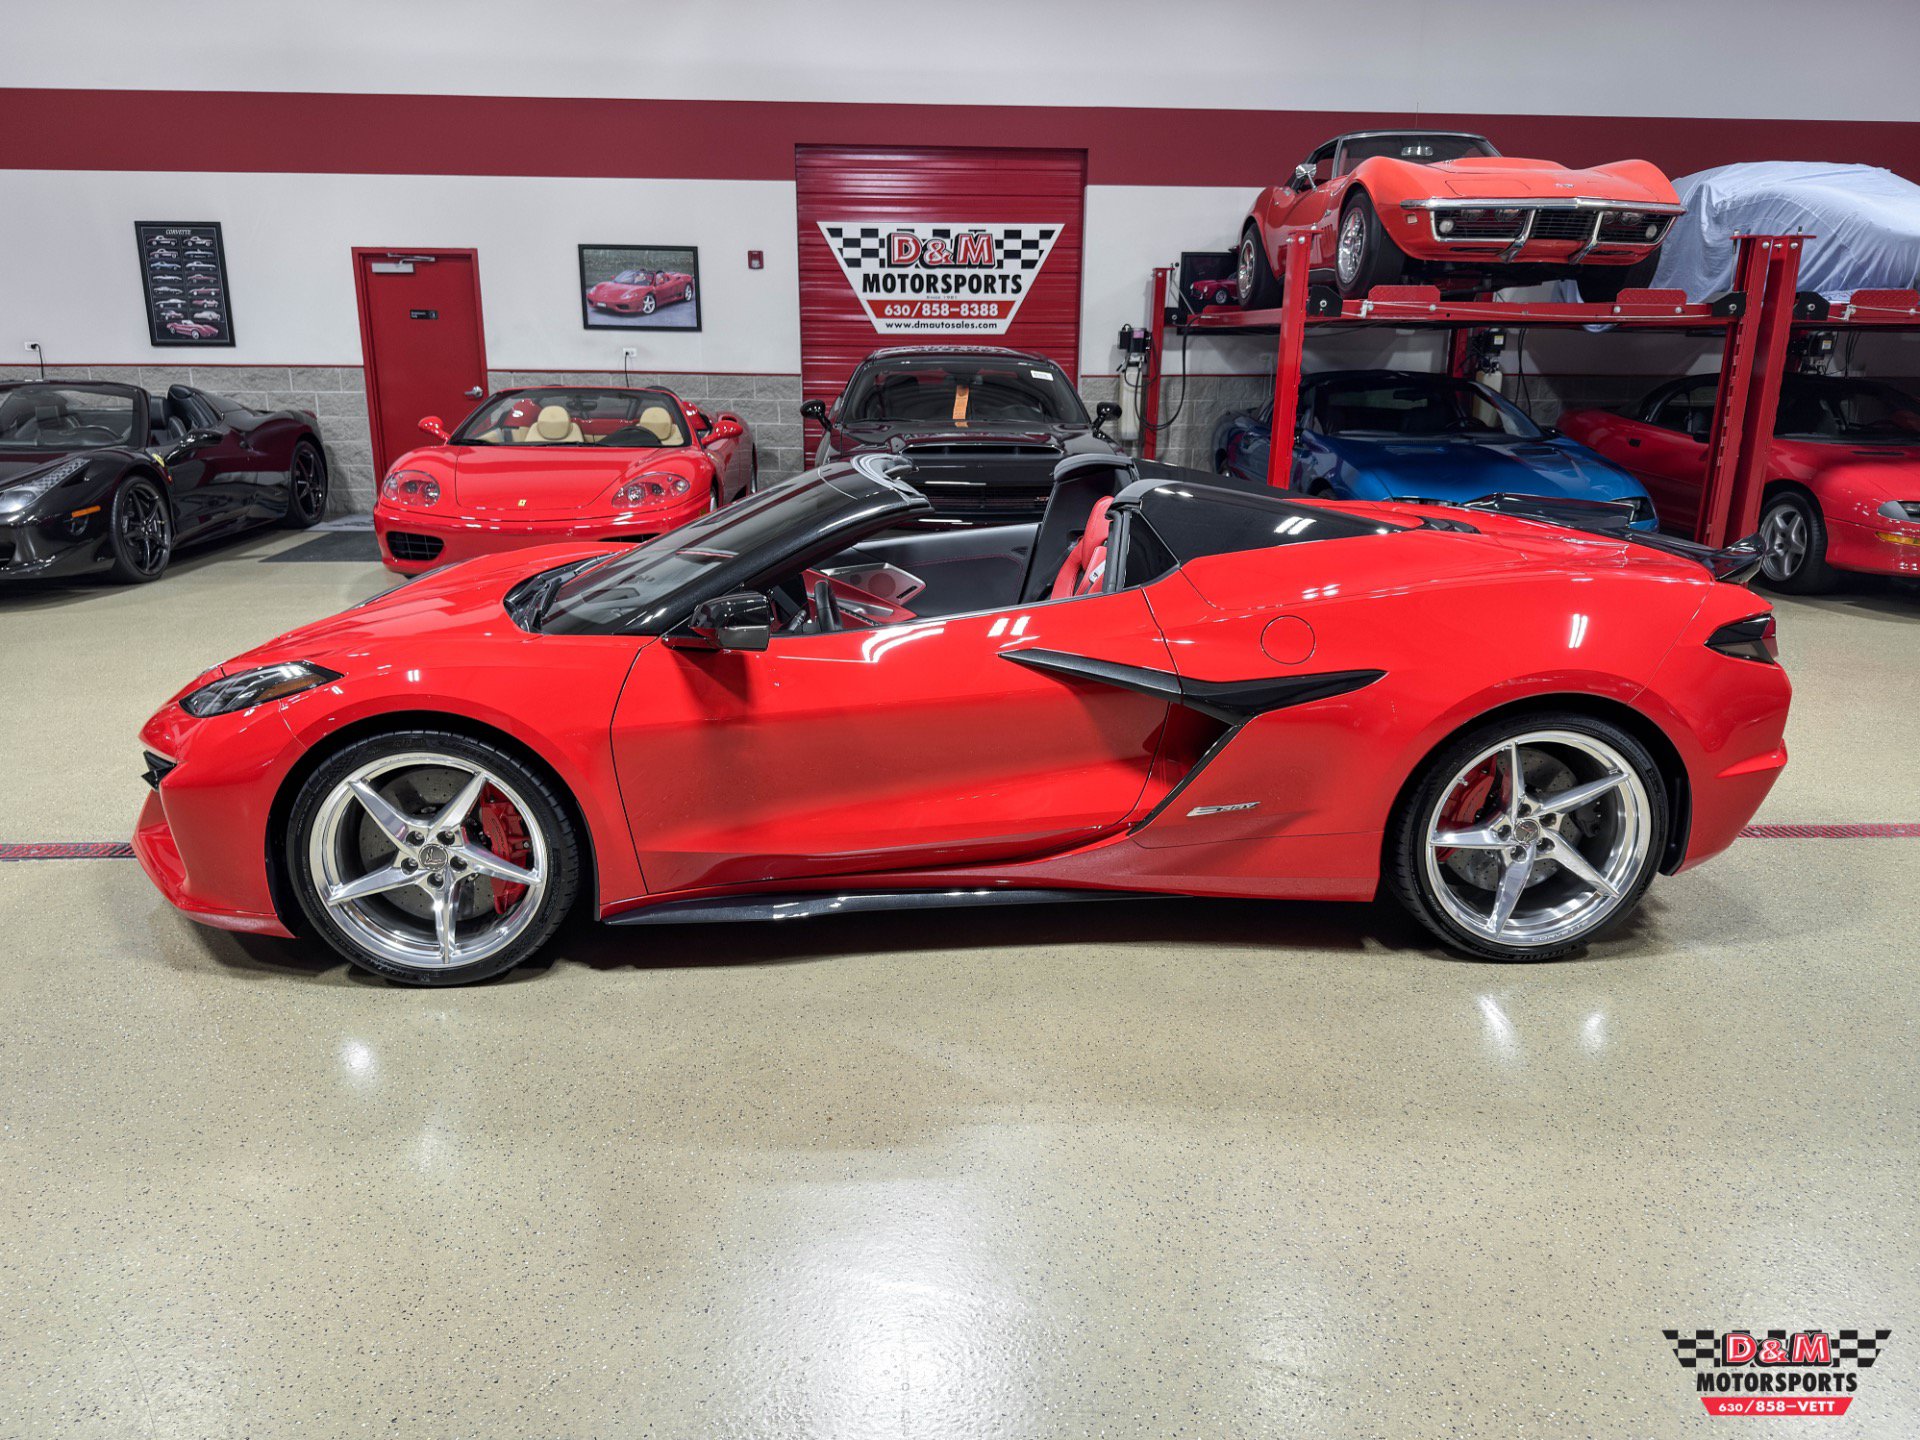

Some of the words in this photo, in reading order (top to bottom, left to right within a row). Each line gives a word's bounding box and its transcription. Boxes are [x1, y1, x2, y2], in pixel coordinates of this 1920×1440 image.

[887, 232, 996, 269] D&M
[862, 273, 1023, 294] MOTORSPORTS
[884, 302, 999, 318] 630/858-8388
[885, 320, 998, 329] www.dmautosales.com
[1531, 920, 1589, 942] CORVETTE
